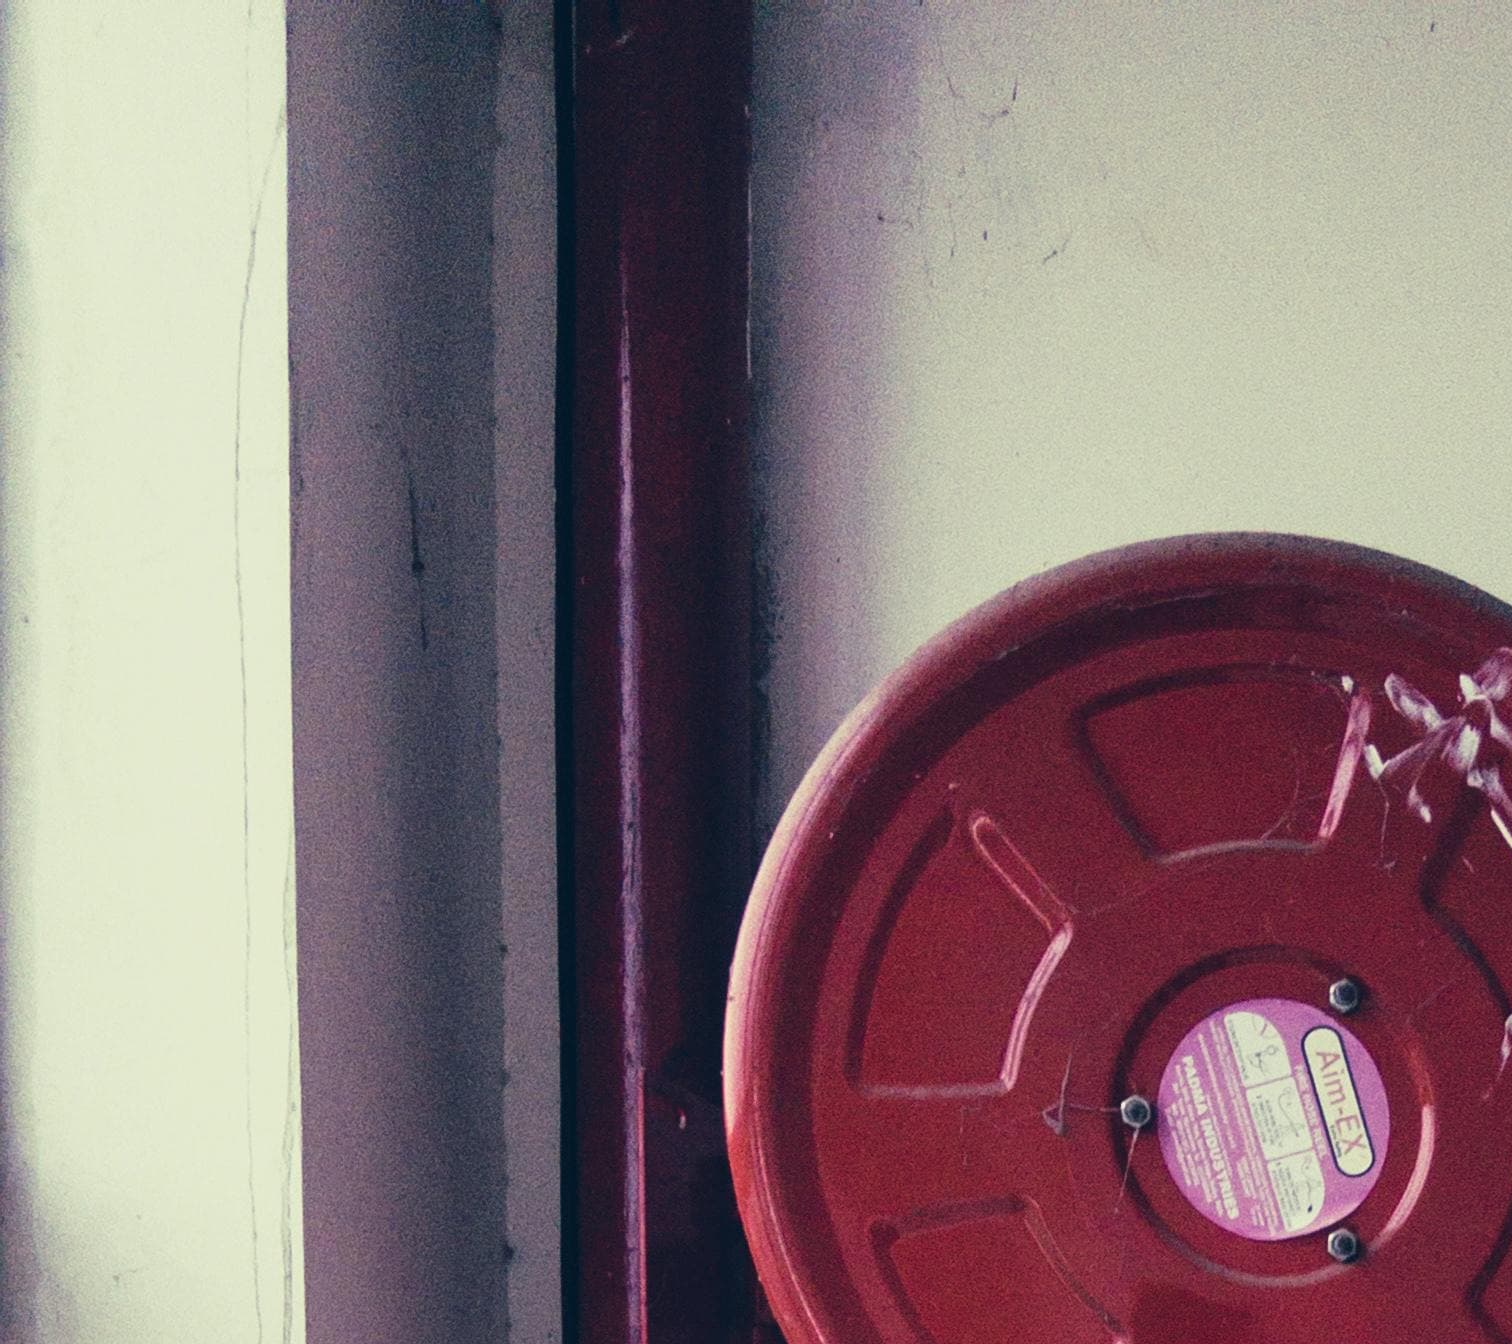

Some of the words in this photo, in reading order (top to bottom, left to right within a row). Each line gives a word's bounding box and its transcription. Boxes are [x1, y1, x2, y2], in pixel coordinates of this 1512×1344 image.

[1181, 1055, 1208, 1115] PADMA
[1200, 1118, 1240, 1220] INDUSTRIES
[1315, 1049, 1367, 1155] Aim-EX
